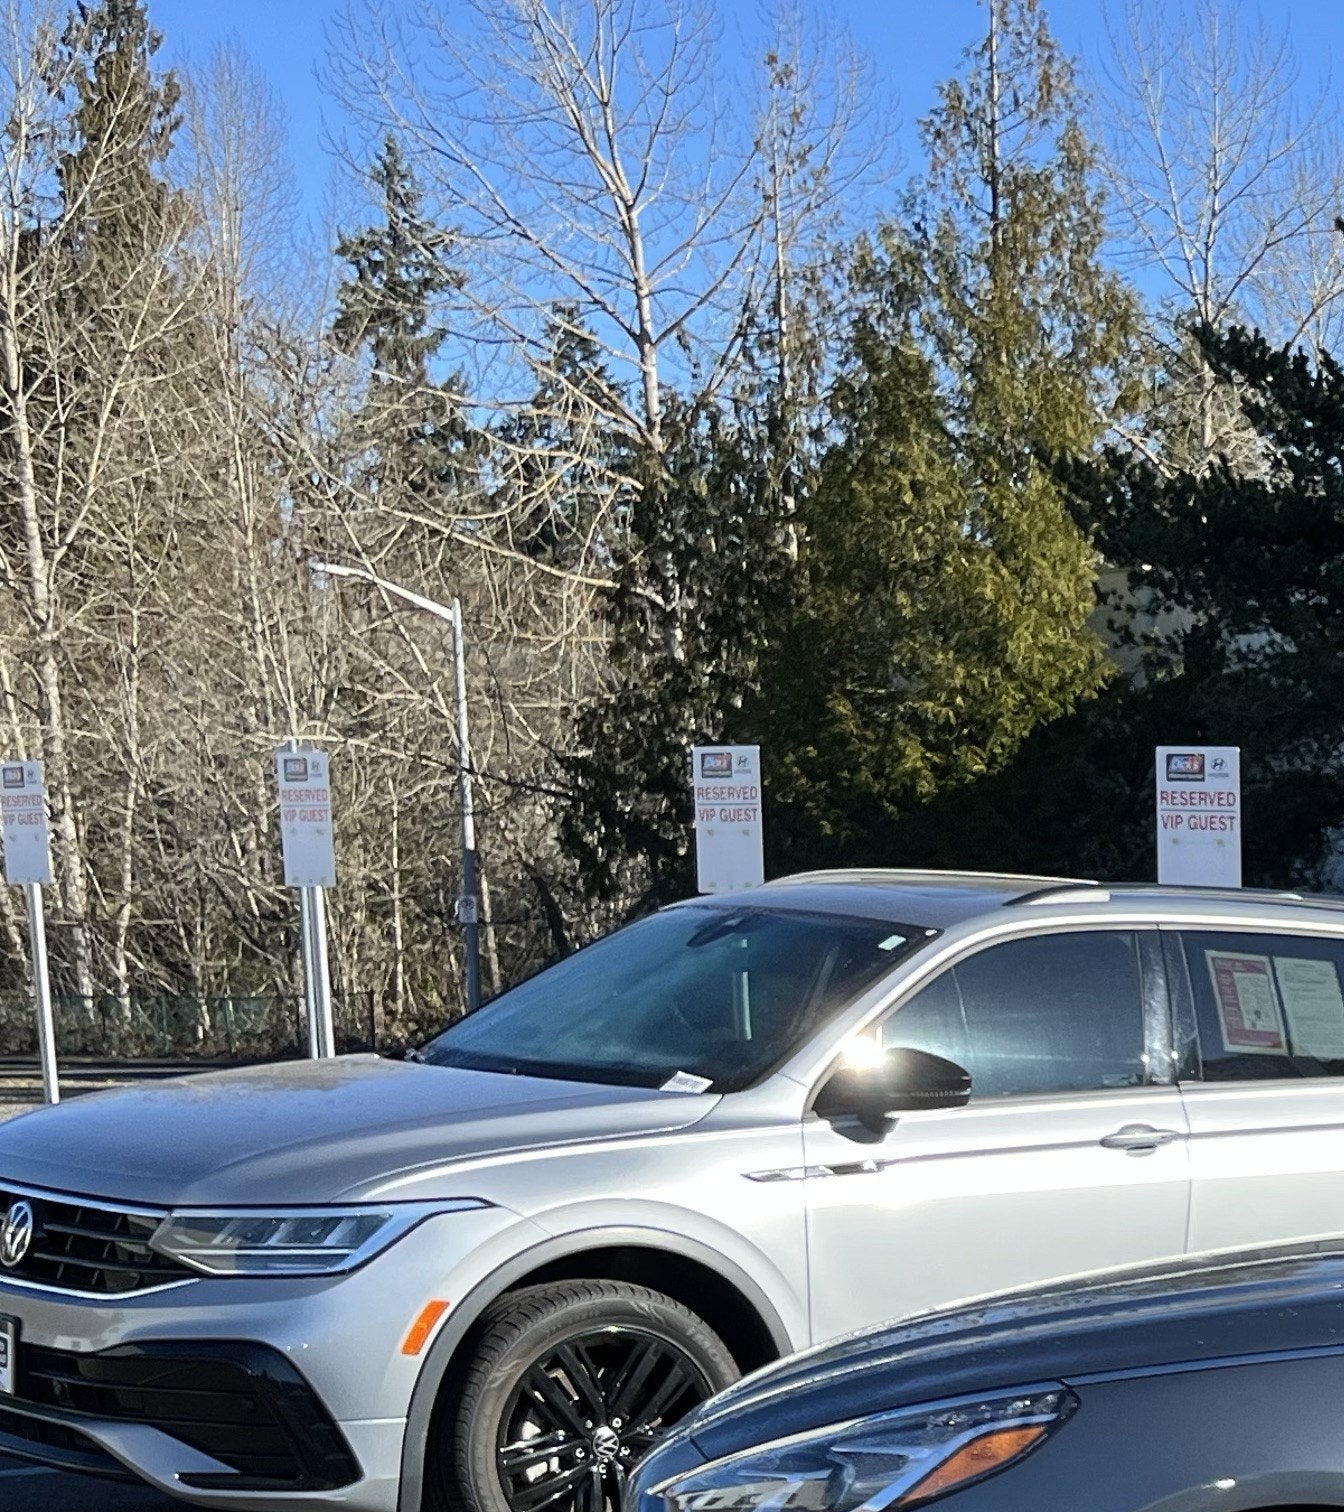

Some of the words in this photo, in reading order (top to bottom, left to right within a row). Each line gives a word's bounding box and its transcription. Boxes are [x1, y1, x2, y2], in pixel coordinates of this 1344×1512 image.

[282, 788, 328, 802] RESERVED
[697, 786, 758, 801] RESERVED
[1160, 790, 1237, 807] RESERVED
[283, 809, 298, 823] VIP
[299, 808, 330, 823] GUEST
[698, 809, 716, 823] VIP
[719, 808, 758, 823] GUEST
[1161, 814, 1184, 830] VIP
[1187, 815, 1236, 832] GUEST
